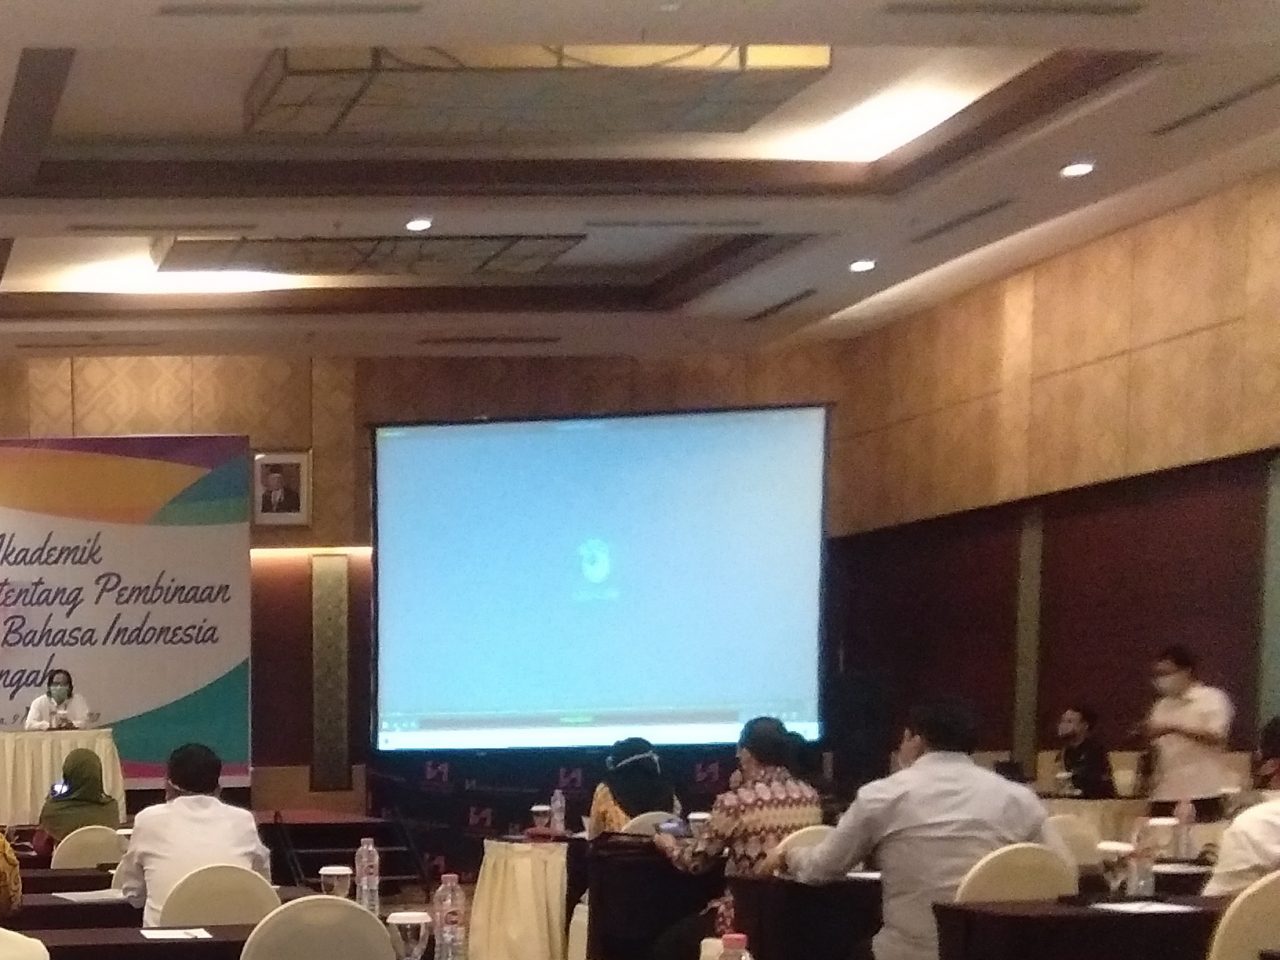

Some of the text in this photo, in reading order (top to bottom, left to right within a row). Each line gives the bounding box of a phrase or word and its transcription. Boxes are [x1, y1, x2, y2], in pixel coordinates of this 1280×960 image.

[94, 570, 231, 606] Pembinaan
[1, 612, 97, 648] Bahasa
[102, 611, 220, 647] Indonesia
